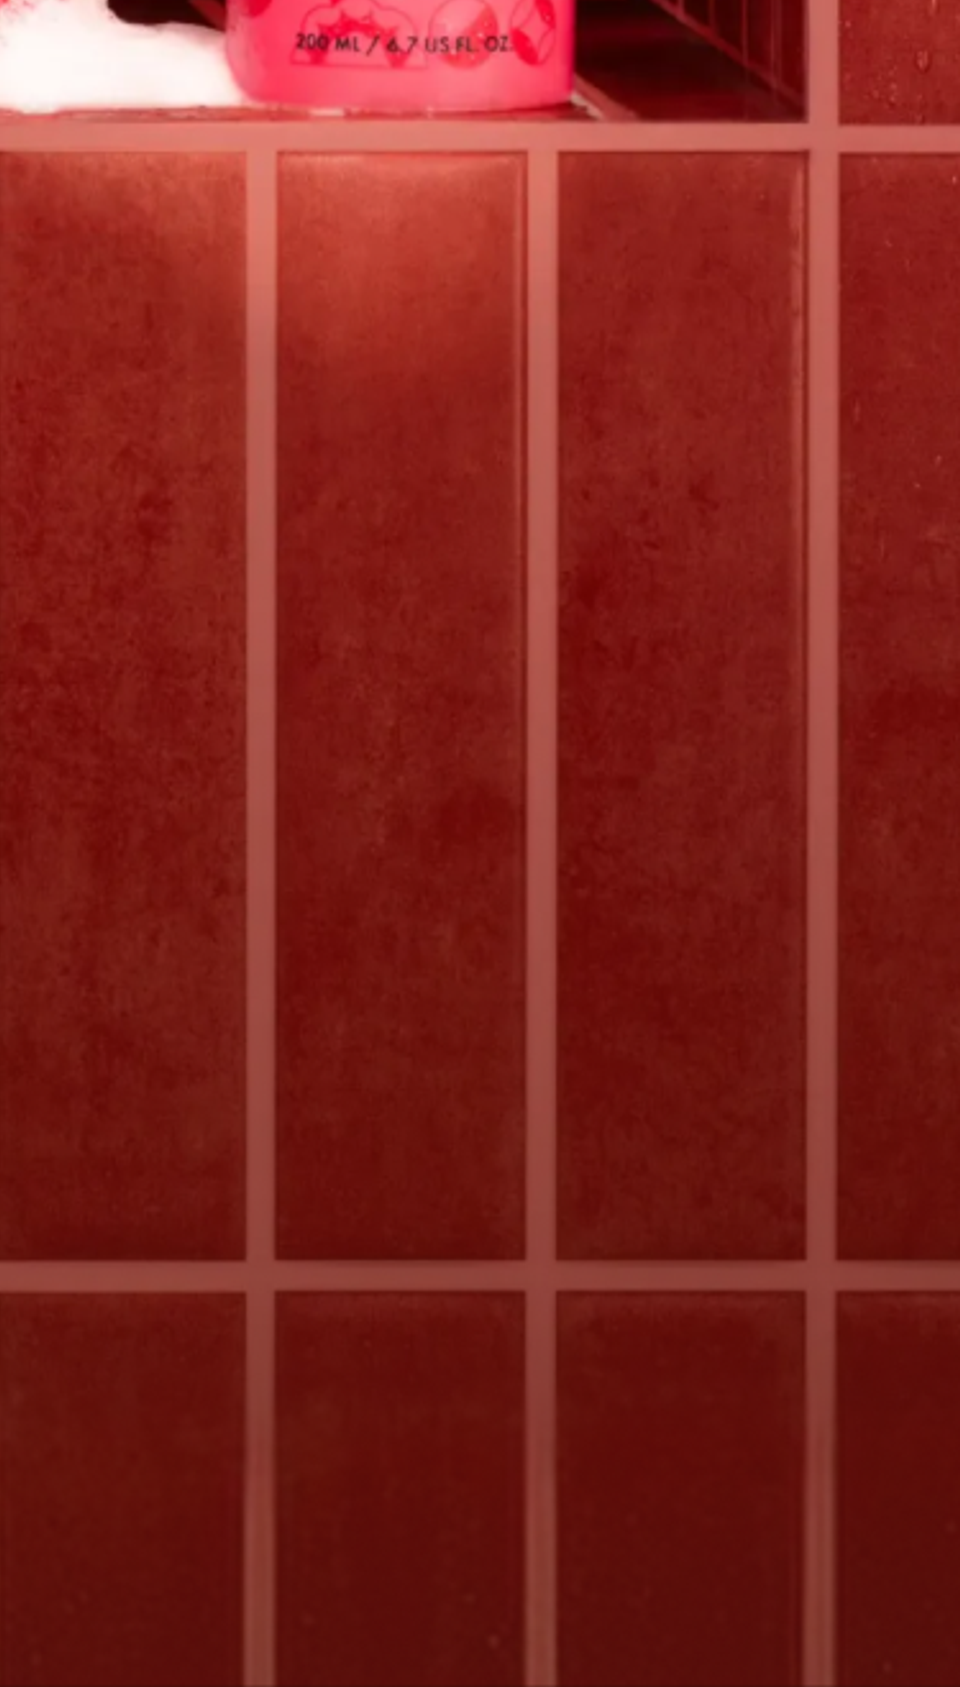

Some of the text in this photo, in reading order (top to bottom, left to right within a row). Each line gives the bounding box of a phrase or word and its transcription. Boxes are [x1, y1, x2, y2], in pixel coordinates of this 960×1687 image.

[296, 32, 331, 52] 200
[334, 36, 360, 52] ML
[365, 33, 381, 57] /
[385, 35, 419, 54] 6.7
[424, 35, 451, 55] US
